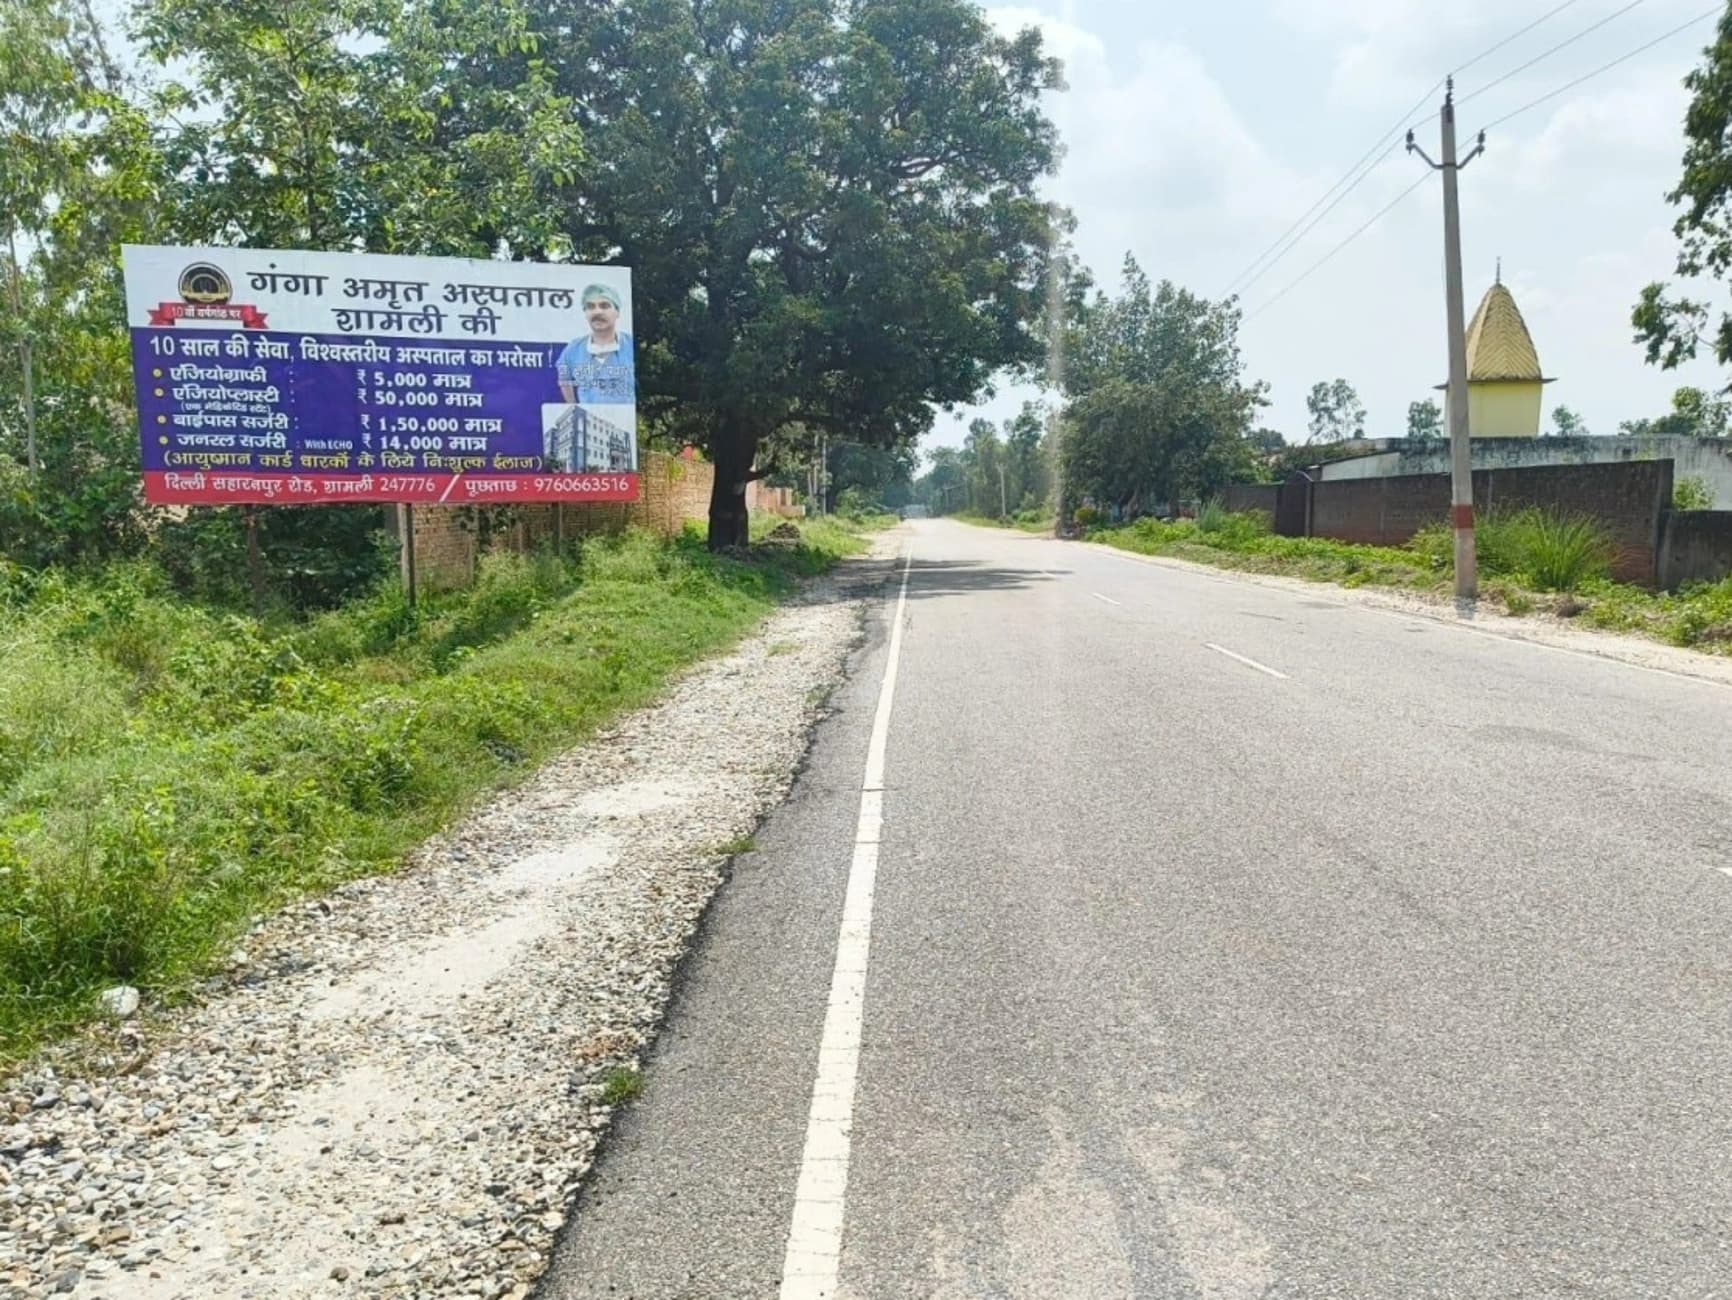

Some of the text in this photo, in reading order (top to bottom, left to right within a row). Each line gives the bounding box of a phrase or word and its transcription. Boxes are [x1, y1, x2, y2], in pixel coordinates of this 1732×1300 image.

[246, 263, 575, 310] गंगा अमृत अस्पताल
[170, 306, 183, 318] 10
[331, 304, 502, 335] शामली की
[150, 335, 175, 356] 10
[180, 336, 219, 358] साल
[224, 333, 250, 359] की
[299, 336, 391, 363] विश्वस्तरीय
[396, 346, 465, 367] अस्पताल
[471, 349, 493, 368] का
[356, 369, 367, 386] ₹
[374, 372, 427, 387] 5,000
[432, 373, 472, 388] मात्र
[357, 388, 368, 404] ₹
[375, 391, 438, 407] 50,000
[442, 392, 484, 407] मात्र
[172, 410, 237, 428] बाईपास
[241, 412, 289, 430] सर्जरी
[361, 413, 371, 430] ₹
[378, 416, 459, 432] 1,50,000
[464, 418, 503, 432] मात्र
[176, 432, 236, 447] जनरल
[239, 431, 286, 449] सर्जरी
[362, 432, 372, 449] ₹
[380, 435, 443, 451] 14,000
[448, 436, 488, 451] मात्र
[258, 450, 294, 468] कार्ड
[357, 451, 375, 467] के
[380, 450, 416, 468] लिये
[163, 472, 206, 491] दिल्ली
[210, 477, 283, 498] सहारनपुर
[287, 476, 318, 494] रोड,
[322, 474, 375, 494] शामली
[380, 477, 436, 492] 247776
[464, 479, 518, 498] पूछताछ
[533, 478, 629, 493] 9760663516
